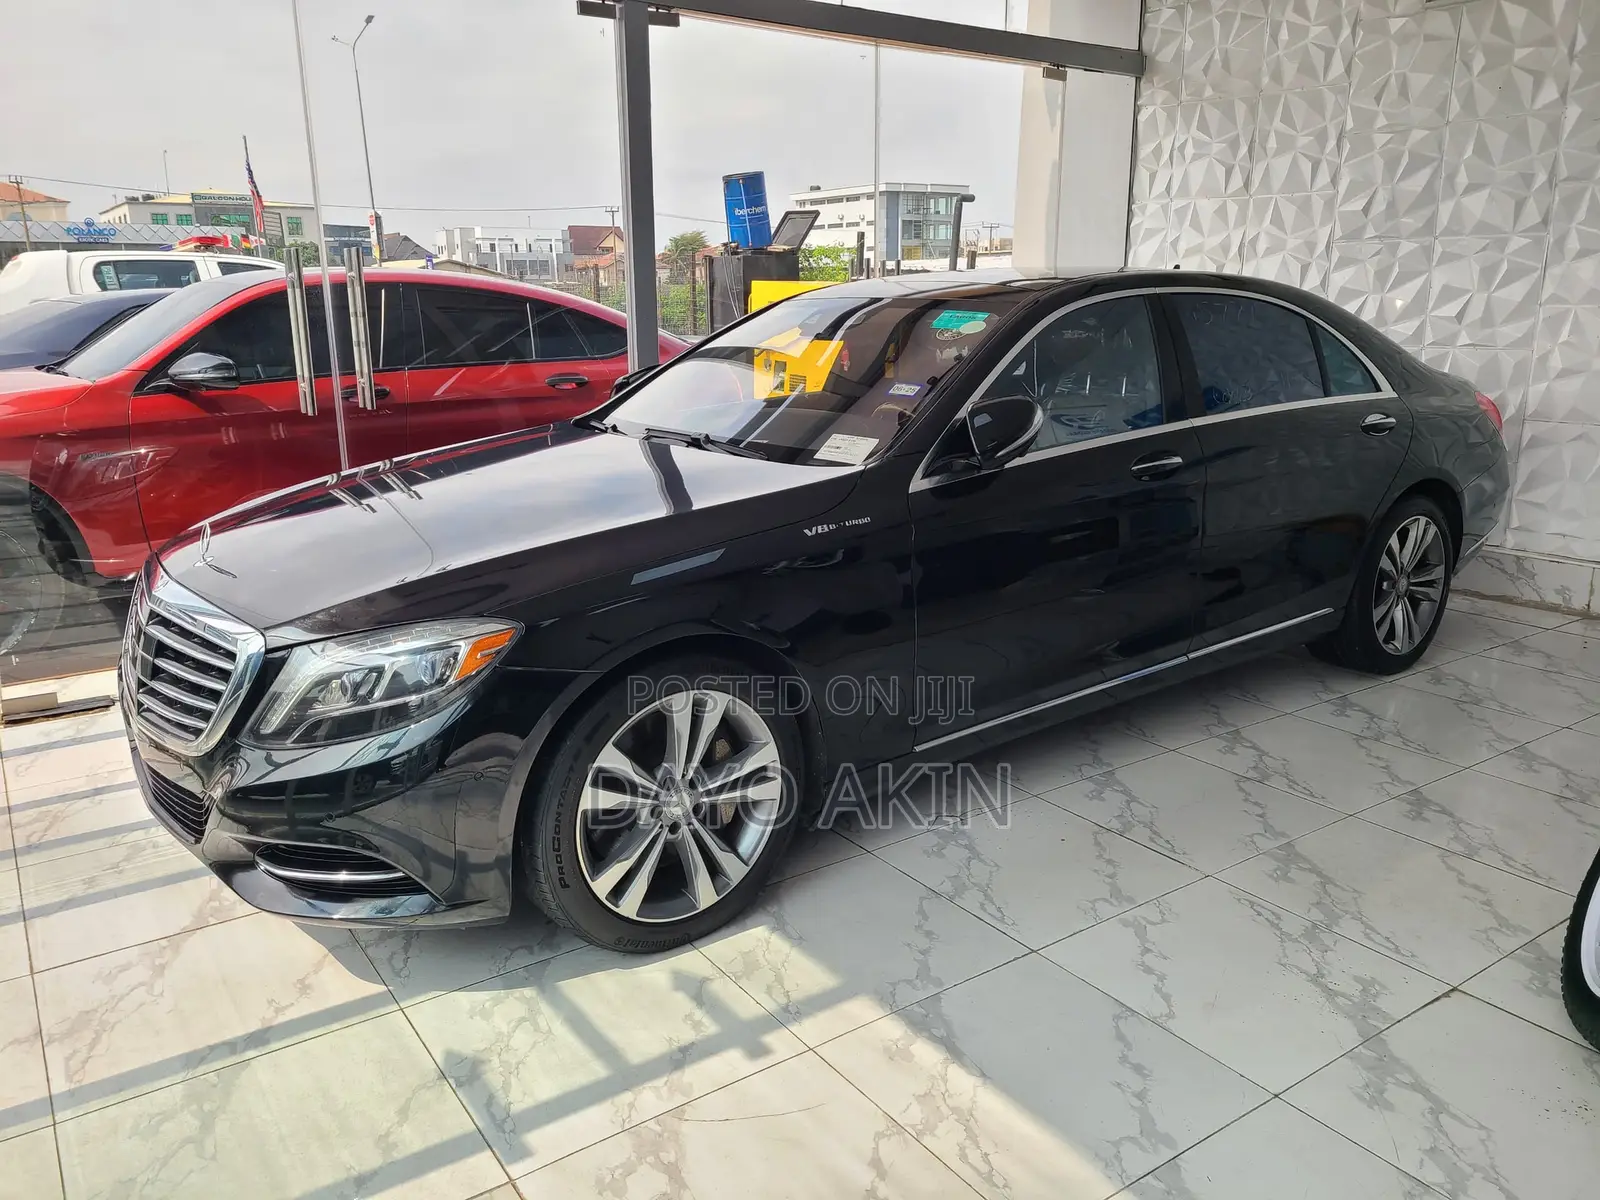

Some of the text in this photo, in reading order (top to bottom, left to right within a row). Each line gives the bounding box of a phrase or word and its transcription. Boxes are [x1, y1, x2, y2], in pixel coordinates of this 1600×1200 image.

[734, 205, 767, 216] iberchem
[64, 227, 117, 237] POLANCO
[803, 523, 830, 537] V8
